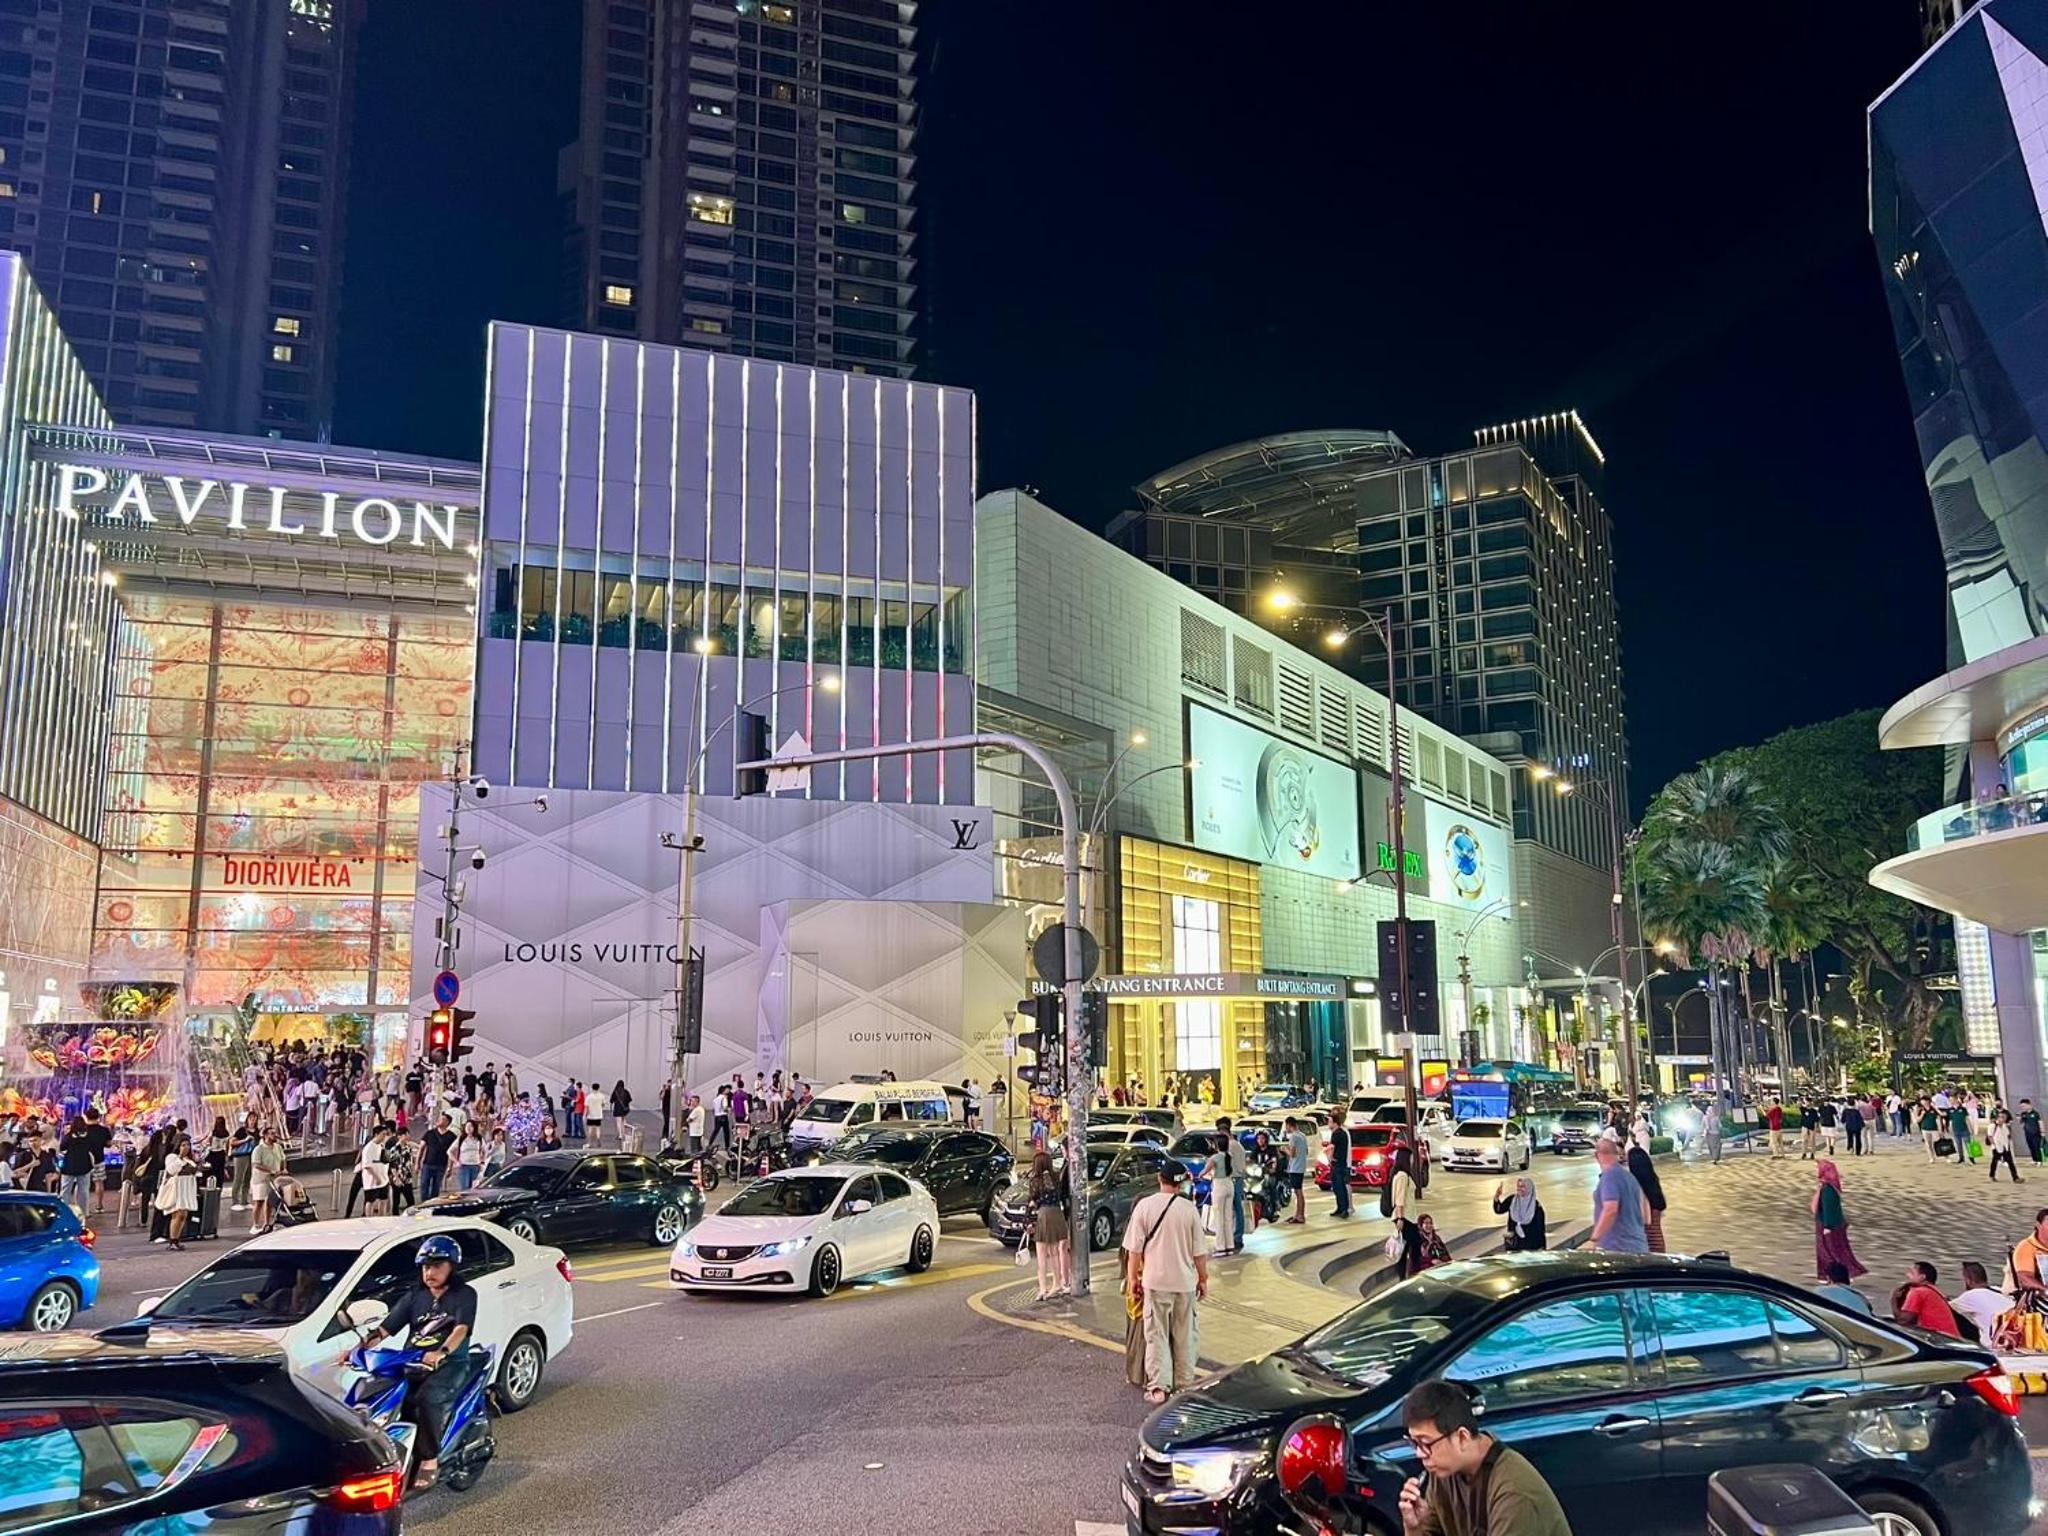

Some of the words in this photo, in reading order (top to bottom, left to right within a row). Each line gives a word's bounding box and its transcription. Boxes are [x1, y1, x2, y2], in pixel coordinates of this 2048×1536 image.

[56, 463, 459, 550] PAVILION
[1019, 849, 1066, 868] Cartie
[1377, 842, 1422, 877] ROEX
[223, 860, 351, 887] DIORIVIERA
[505, 943, 583, 963] LOUIS
[1144, 976, 1225, 993] ENTRANCE
[1306, 982, 1337, 995] ENTRANCE
[849, 1031, 882, 1043] LOUIS
[886, 1031, 932, 1043] VUITTON
